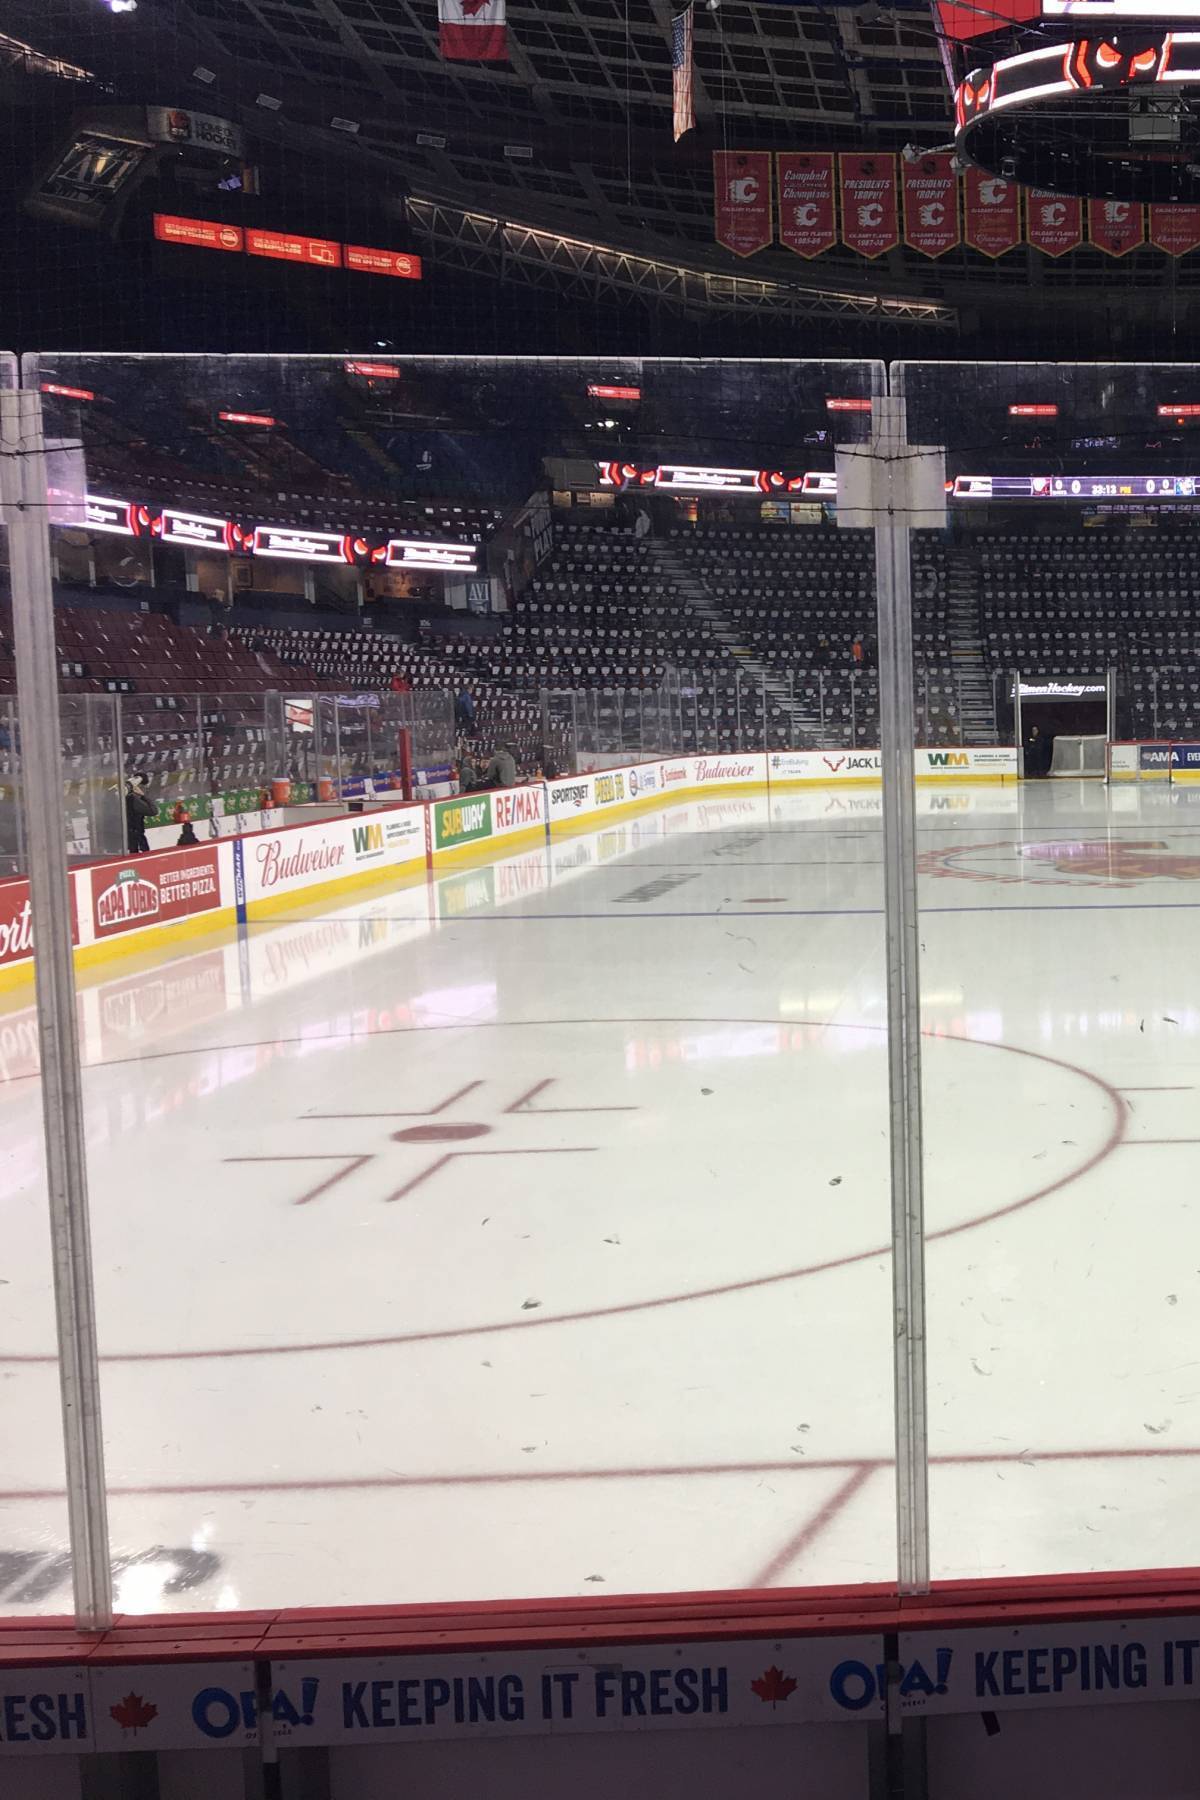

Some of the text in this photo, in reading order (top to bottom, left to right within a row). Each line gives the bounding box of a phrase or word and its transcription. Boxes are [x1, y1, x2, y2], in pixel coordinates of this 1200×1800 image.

[695, 759, 754, 781] Budweiser
[846, 757, 872, 770] JACK
[928, 752, 970, 766] WM
[1149, 751, 1180, 762] AMA
[496, 790, 541, 829] RE/MAX
[551, 784, 589, 805] SPORTSNET
[441, 802, 487, 839] SUBWAY
[352, 823, 385, 853] WM
[256, 838, 345, 888] Budweiser
[159, 872, 181, 885] BETTER
[99, 884, 125, 924] PAPA
[160, 889, 192, 904] BETTER
[974, 1641, 1147, 1697] KEEPING
[1163, 1640, 1200, 1686] IT
[343, 1674, 527, 1729] KEEPING
[542, 1673, 581, 1719] IT
[595, 1666, 730, 1718] FRESH
[0, 1694, 87, 1742] ESH
